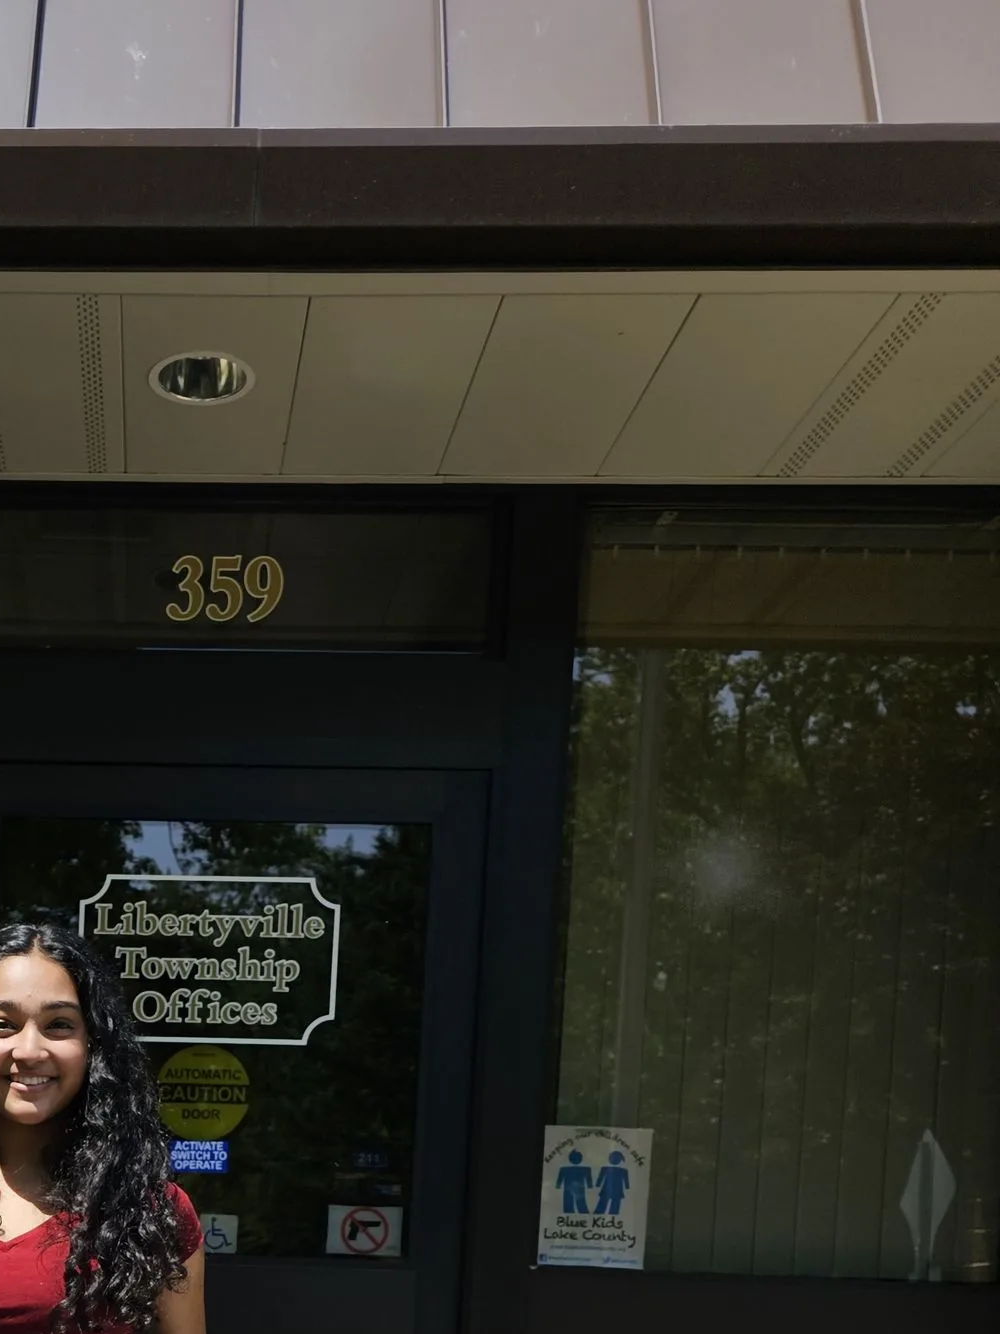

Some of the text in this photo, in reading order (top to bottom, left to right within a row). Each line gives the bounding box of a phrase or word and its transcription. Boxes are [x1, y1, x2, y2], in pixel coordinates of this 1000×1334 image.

[166, 555, 284, 623] 359
[94, 900, 325, 947] Libertyville
[115, 946, 300, 993] Township
[132, 987, 278, 1026] Offices
[165, 1067, 242, 1081] AUTOMATIC
[159, 1085, 247, 1103] CAUTION
[181, 1108, 220, 1121] DOOR
[174, 1141, 224, 1151] ACTIVATE
[170, 1150, 228, 1161] SWITCH TO
[174, 1160, 223, 1170] OPERATE
[556, 1216, 624, 1229] Blue Kids
[544, 1228, 578, 1240] Lake
[583, 1229, 636, 1248] County
